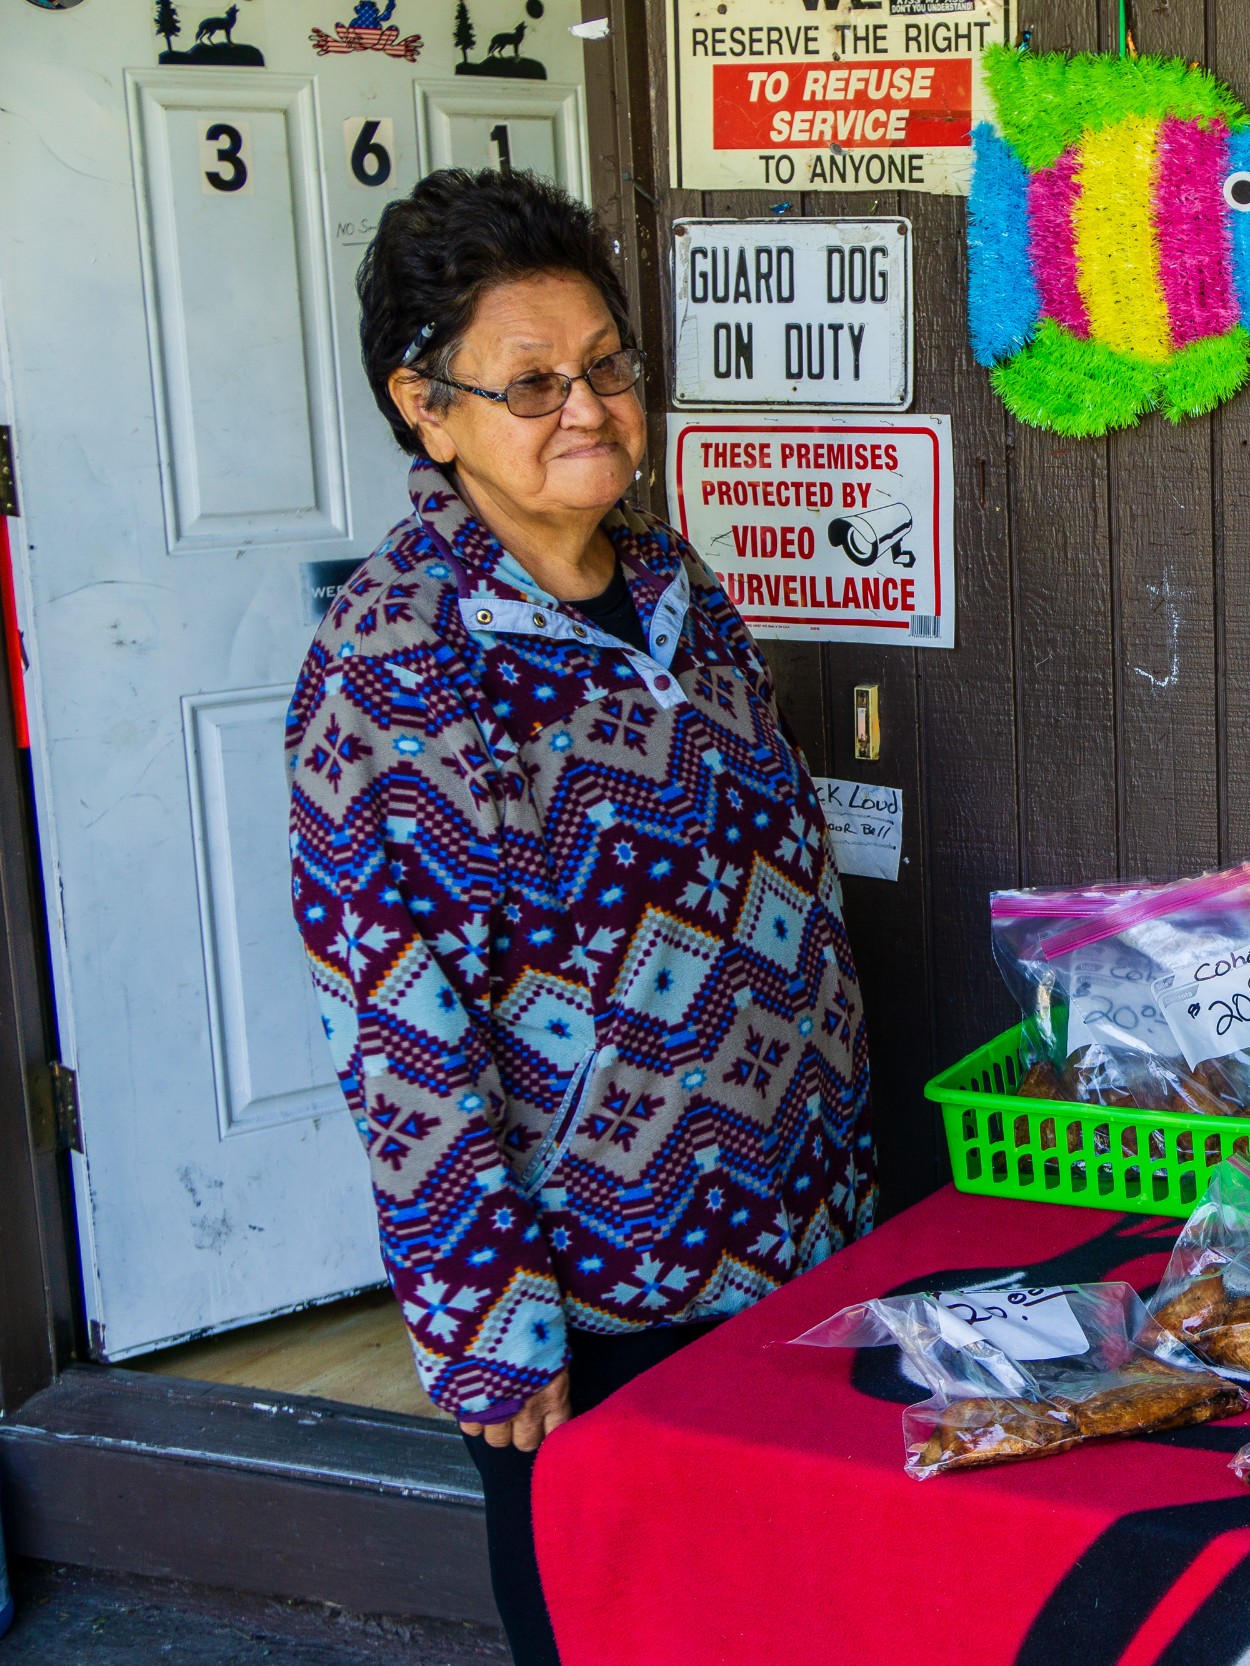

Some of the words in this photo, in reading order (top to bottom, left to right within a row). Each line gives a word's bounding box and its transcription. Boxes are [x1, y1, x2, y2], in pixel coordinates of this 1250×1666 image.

[912, 4, 926, 12] YOU
[692, 25, 820, 57] RESERVE
[836, 24, 889, 55] THE
[905, 21, 991, 53] RIGHT
[747, 70, 789, 102] TO
[803, 67, 935, 101] REFUSE
[770, 109, 910, 142] SERVICE
[206, 124, 249, 192] 3
[351, 120, 391, 187] 6
[759, 154, 795, 184] TO
[810, 153, 924, 184] ANYONE
[690, 245, 795, 304] GUARD
[826, 245, 889, 304] DOG
[713, 322, 754, 380] ON
[785, 322, 866, 381] DUTY
[701, 442, 772, 468] THESE
[781, 443, 899, 471] PREMISES
[702, 480, 833, 508] PROTECTED
[842, 482, 872, 509] BY
[732, 525, 815, 560] VIDEO
